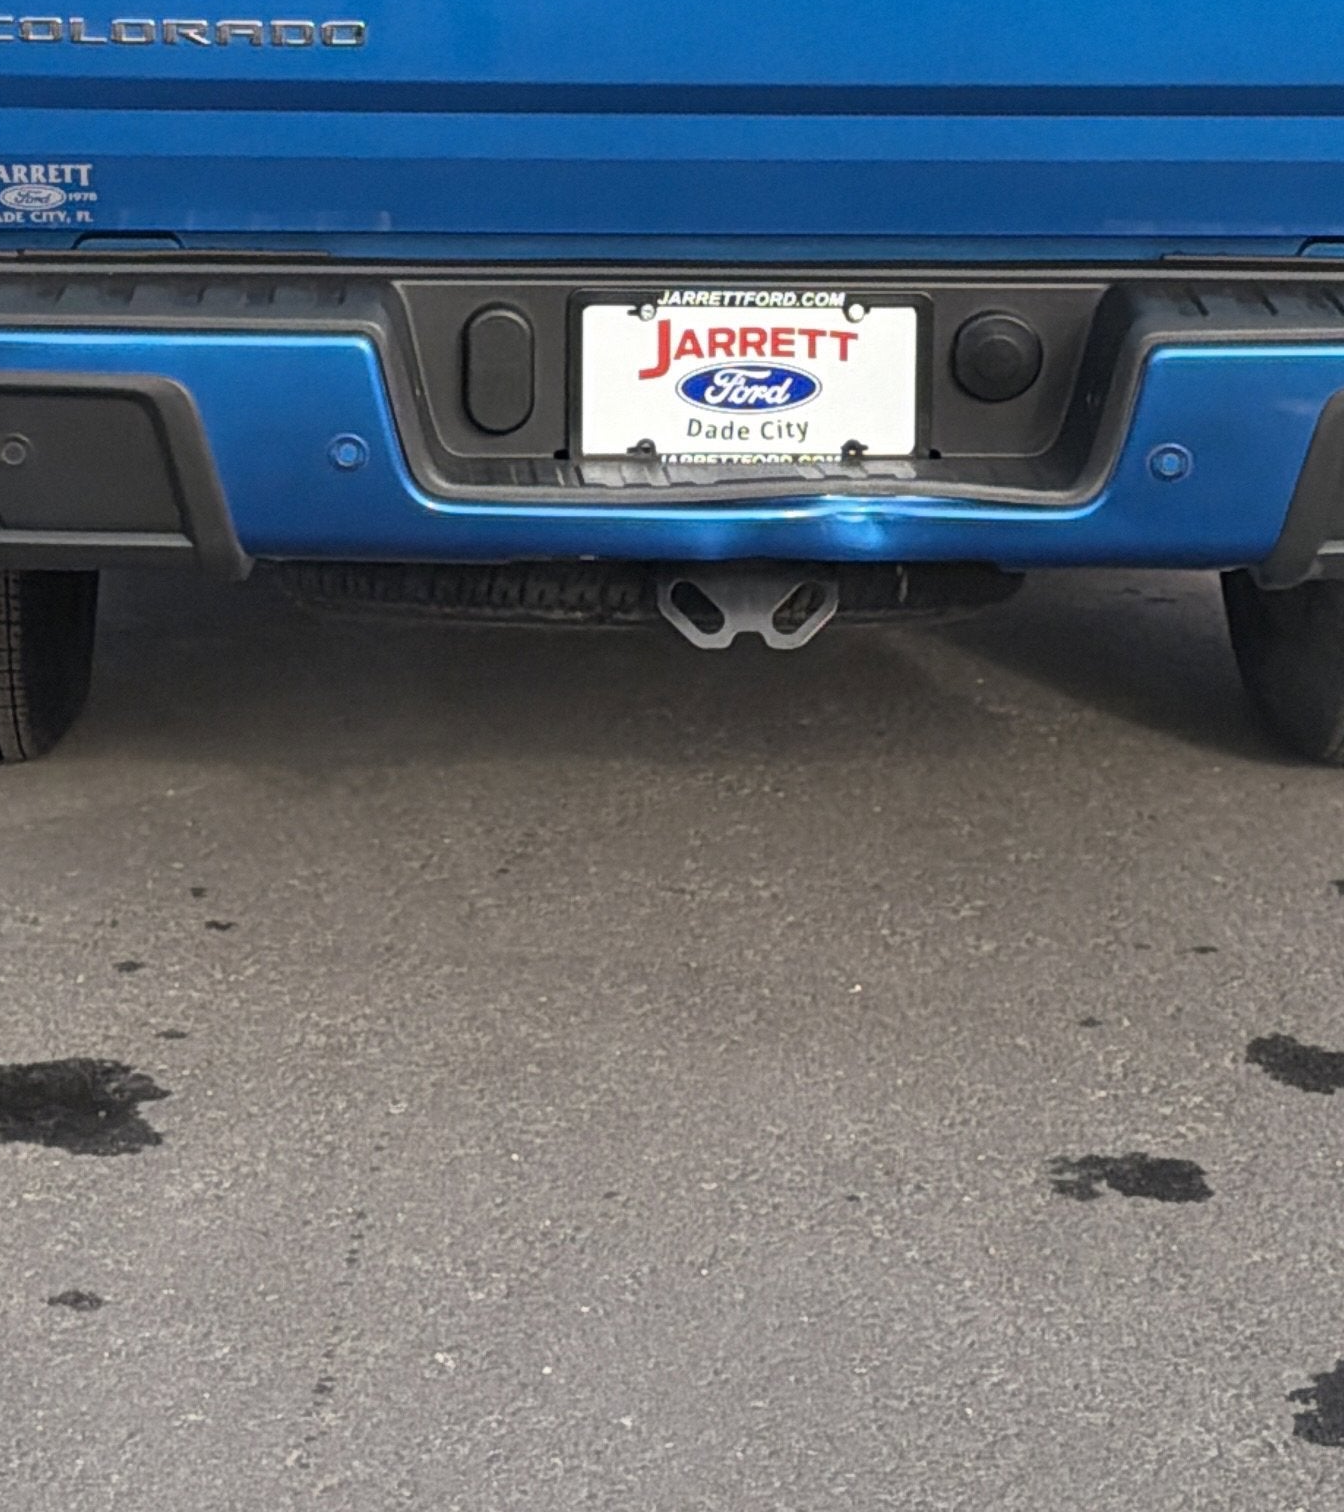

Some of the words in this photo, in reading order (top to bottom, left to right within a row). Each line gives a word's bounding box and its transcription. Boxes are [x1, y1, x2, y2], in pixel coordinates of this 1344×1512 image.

[13, 189, 52, 205] Ford
[30, 211, 72, 225] CITY,
[76, 211, 94, 223] FL
[657, 290, 846, 307] JARRETTFORD.COM
[638, 319, 859, 381] JARRETT
[704, 367, 794, 405] Ford
[686, 418, 750, 441] Dade
[760, 419, 809, 442] City
